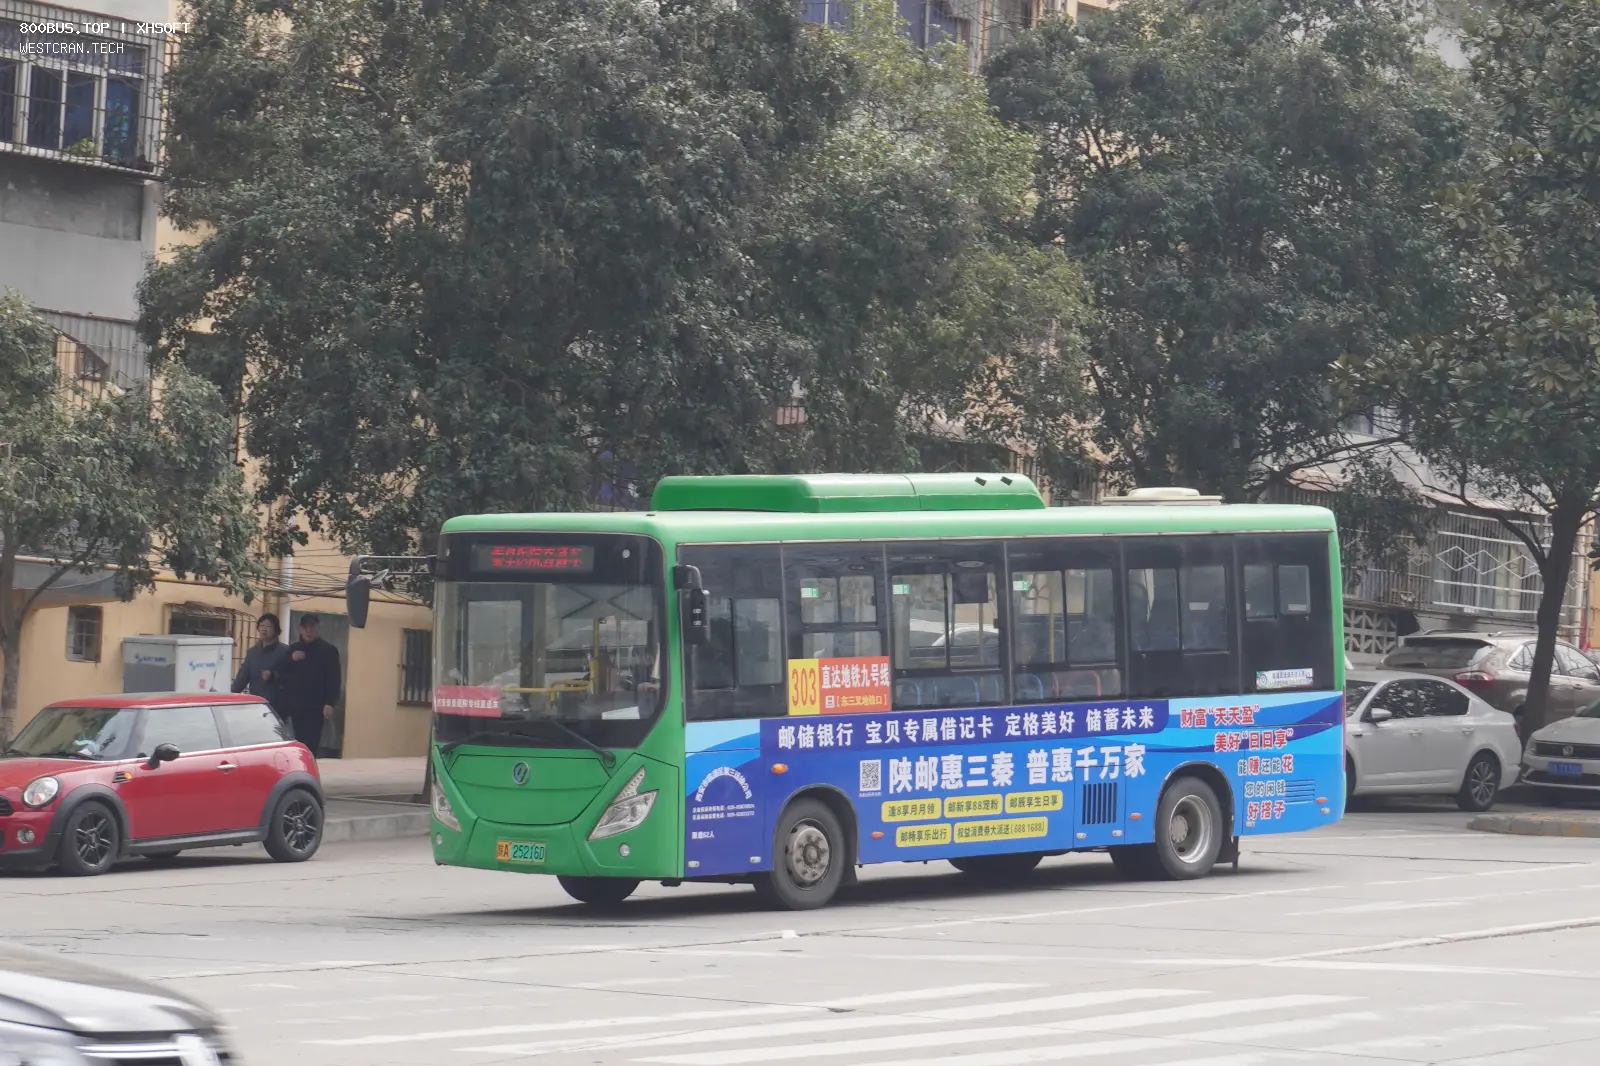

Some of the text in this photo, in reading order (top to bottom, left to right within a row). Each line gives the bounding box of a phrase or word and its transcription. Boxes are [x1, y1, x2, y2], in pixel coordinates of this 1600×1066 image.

[792, 668, 816, 706] 303
[821, 663, 890, 689] 直达地铁九号线
[778, 706, 1154, 749] 邮储银行 宝贝专属借记卡 定格美好 储蓄未来
[889, 742, 1146, 794] 陕邮惠三秦 普惠千万家
[1237, 754, 1294, 776] 能赚还能花
[1247, 801, 1286, 820] 好搭子
